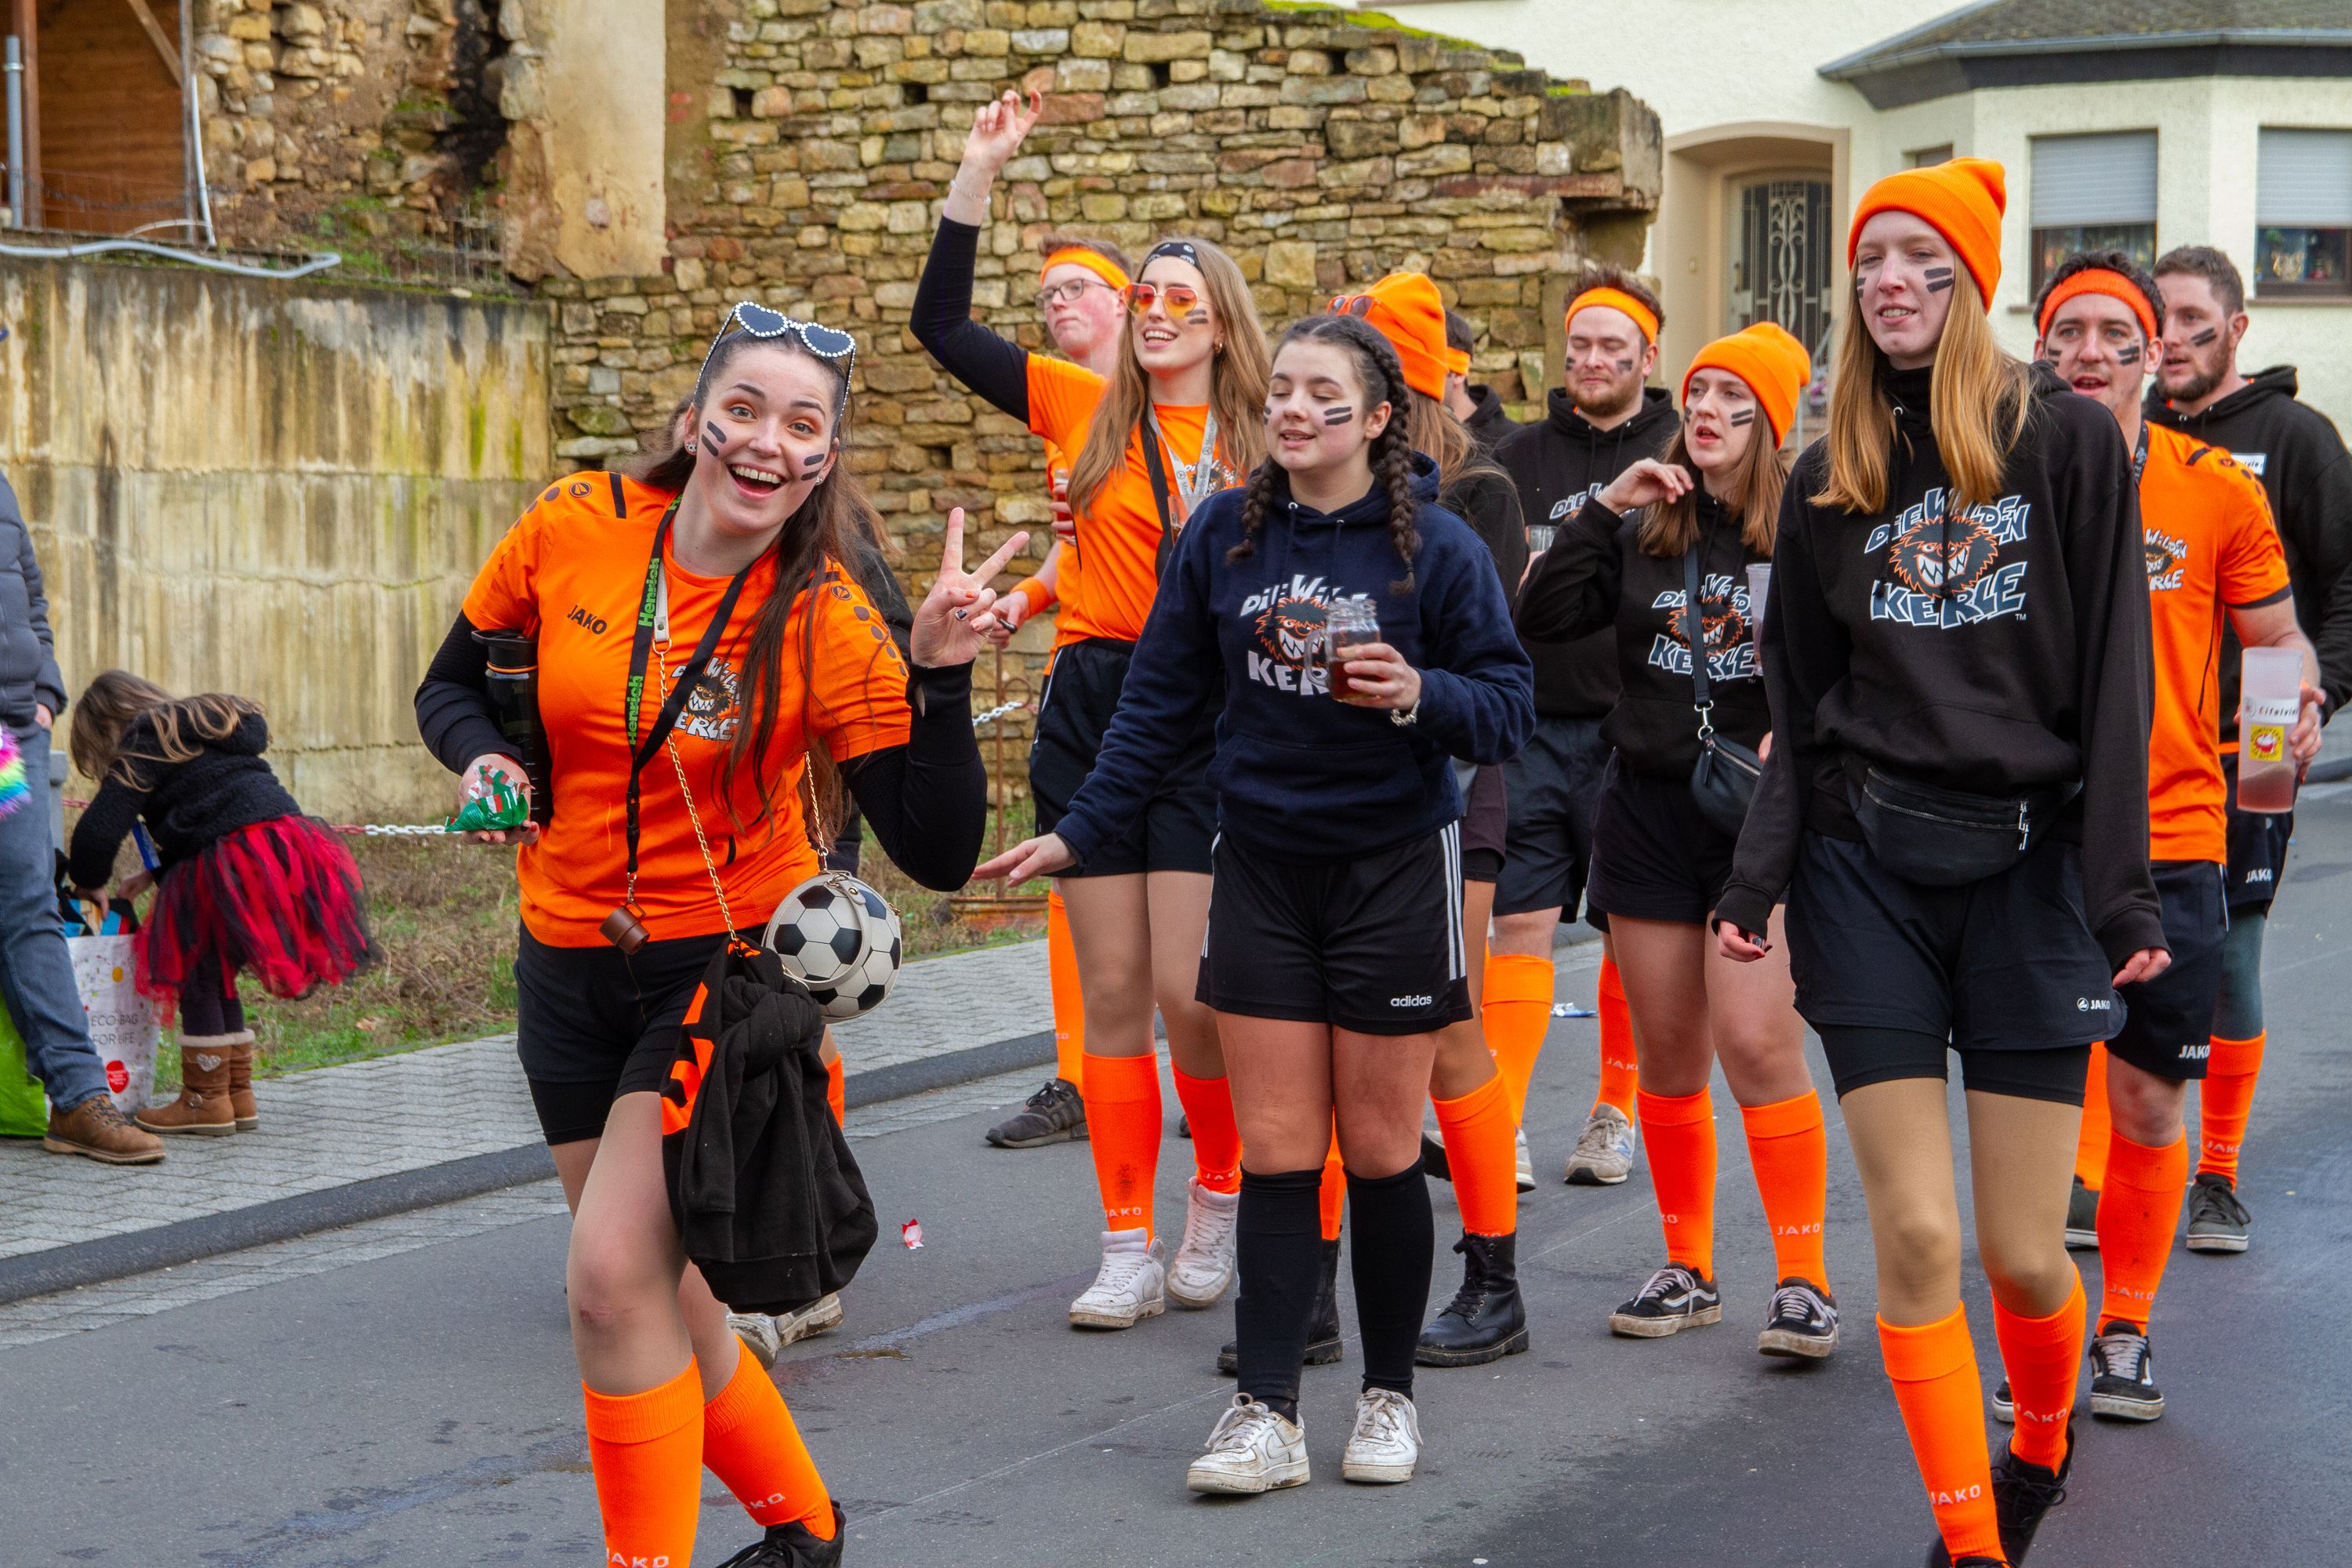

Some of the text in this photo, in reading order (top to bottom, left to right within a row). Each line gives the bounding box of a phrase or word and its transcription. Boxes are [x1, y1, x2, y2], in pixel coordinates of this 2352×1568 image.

[2149, 568, 2185, 592] RLE
[638, 557, 660, 626] Henrich
[1870, 561, 2028, 630] KERLE
[567, 605, 608, 635] JAKO
[1247, 650, 1330, 695] KER
[674, 711, 739, 741] ERLE
[2245, 868, 2273, 884] JAKO
[1391, 995, 1432, 1007] adidas
[2090, 1000, 2111, 1010] JAKO
[93, 1033, 116, 1045] FOR
[2179, 1044, 2211, 1058] JAKO
[1777, 1223, 1820, 1236] JAKO
[1930, 1485, 1981, 1505] JAKO
